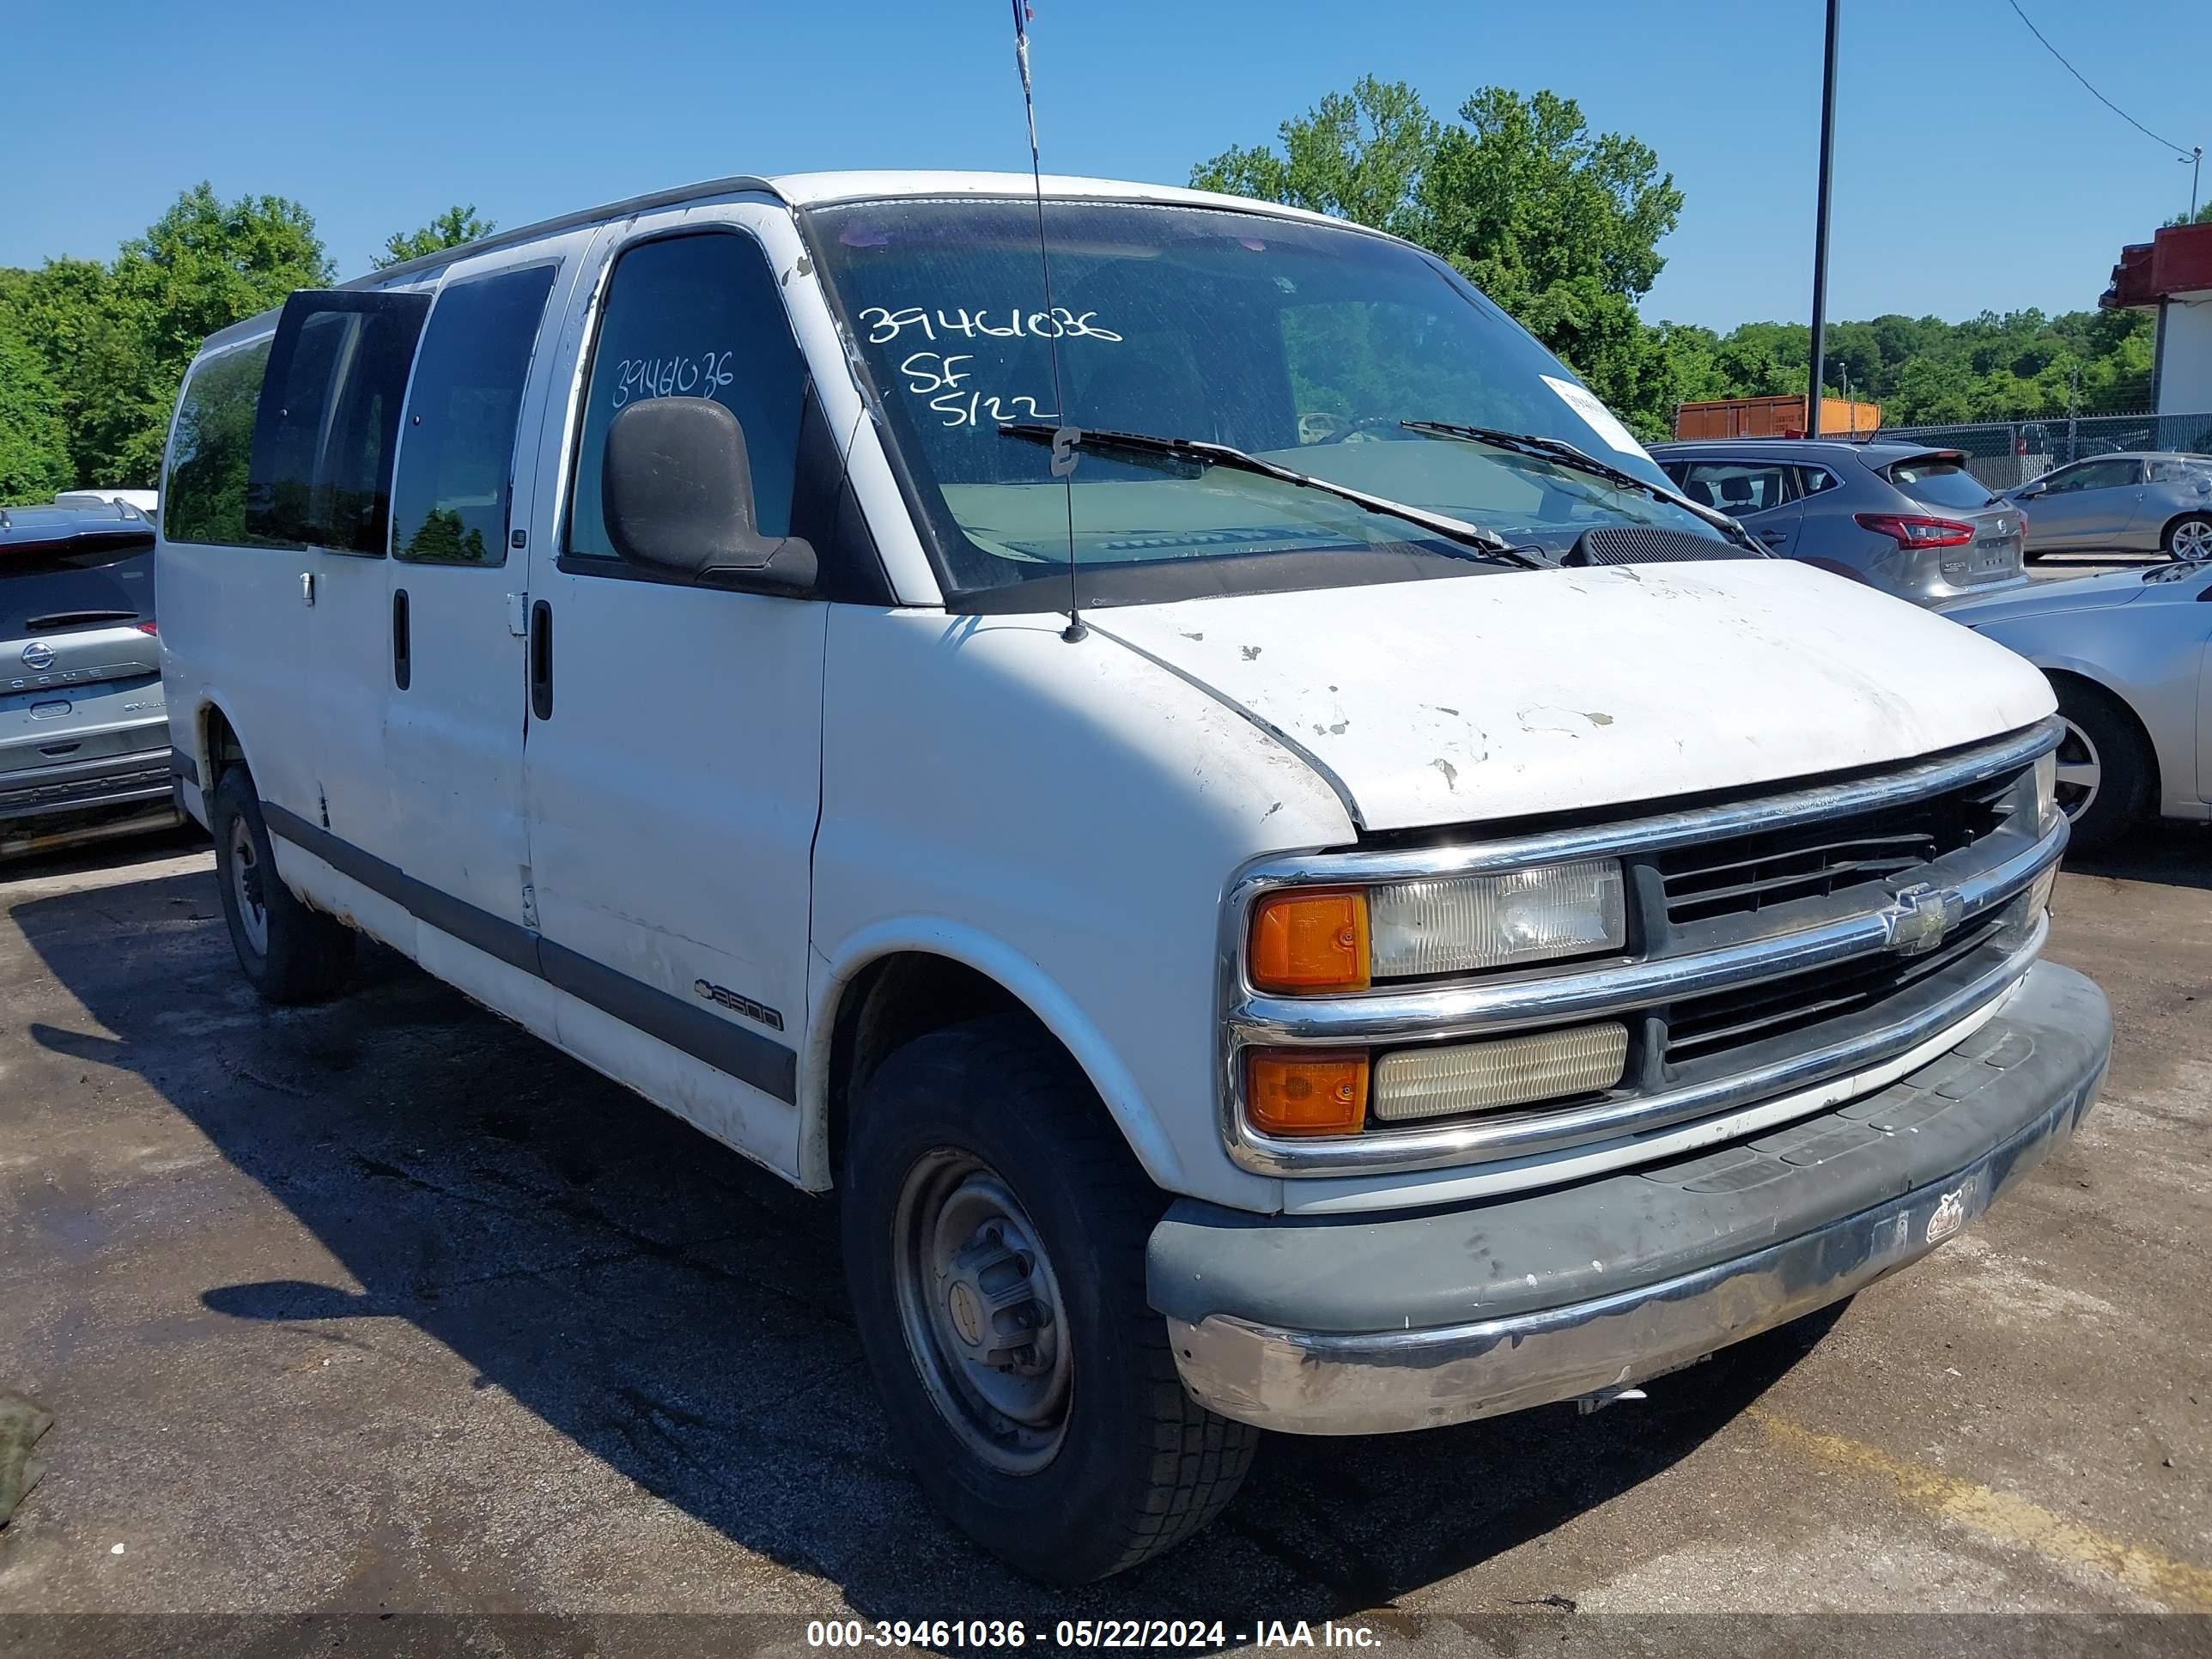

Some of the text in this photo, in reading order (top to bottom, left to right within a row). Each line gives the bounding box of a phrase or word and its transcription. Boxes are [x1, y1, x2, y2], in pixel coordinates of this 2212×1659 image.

[859, 307, 1123, 343] 39461036
[901, 352, 974, 393] SF
[713, 986, 783, 1031] 3500
